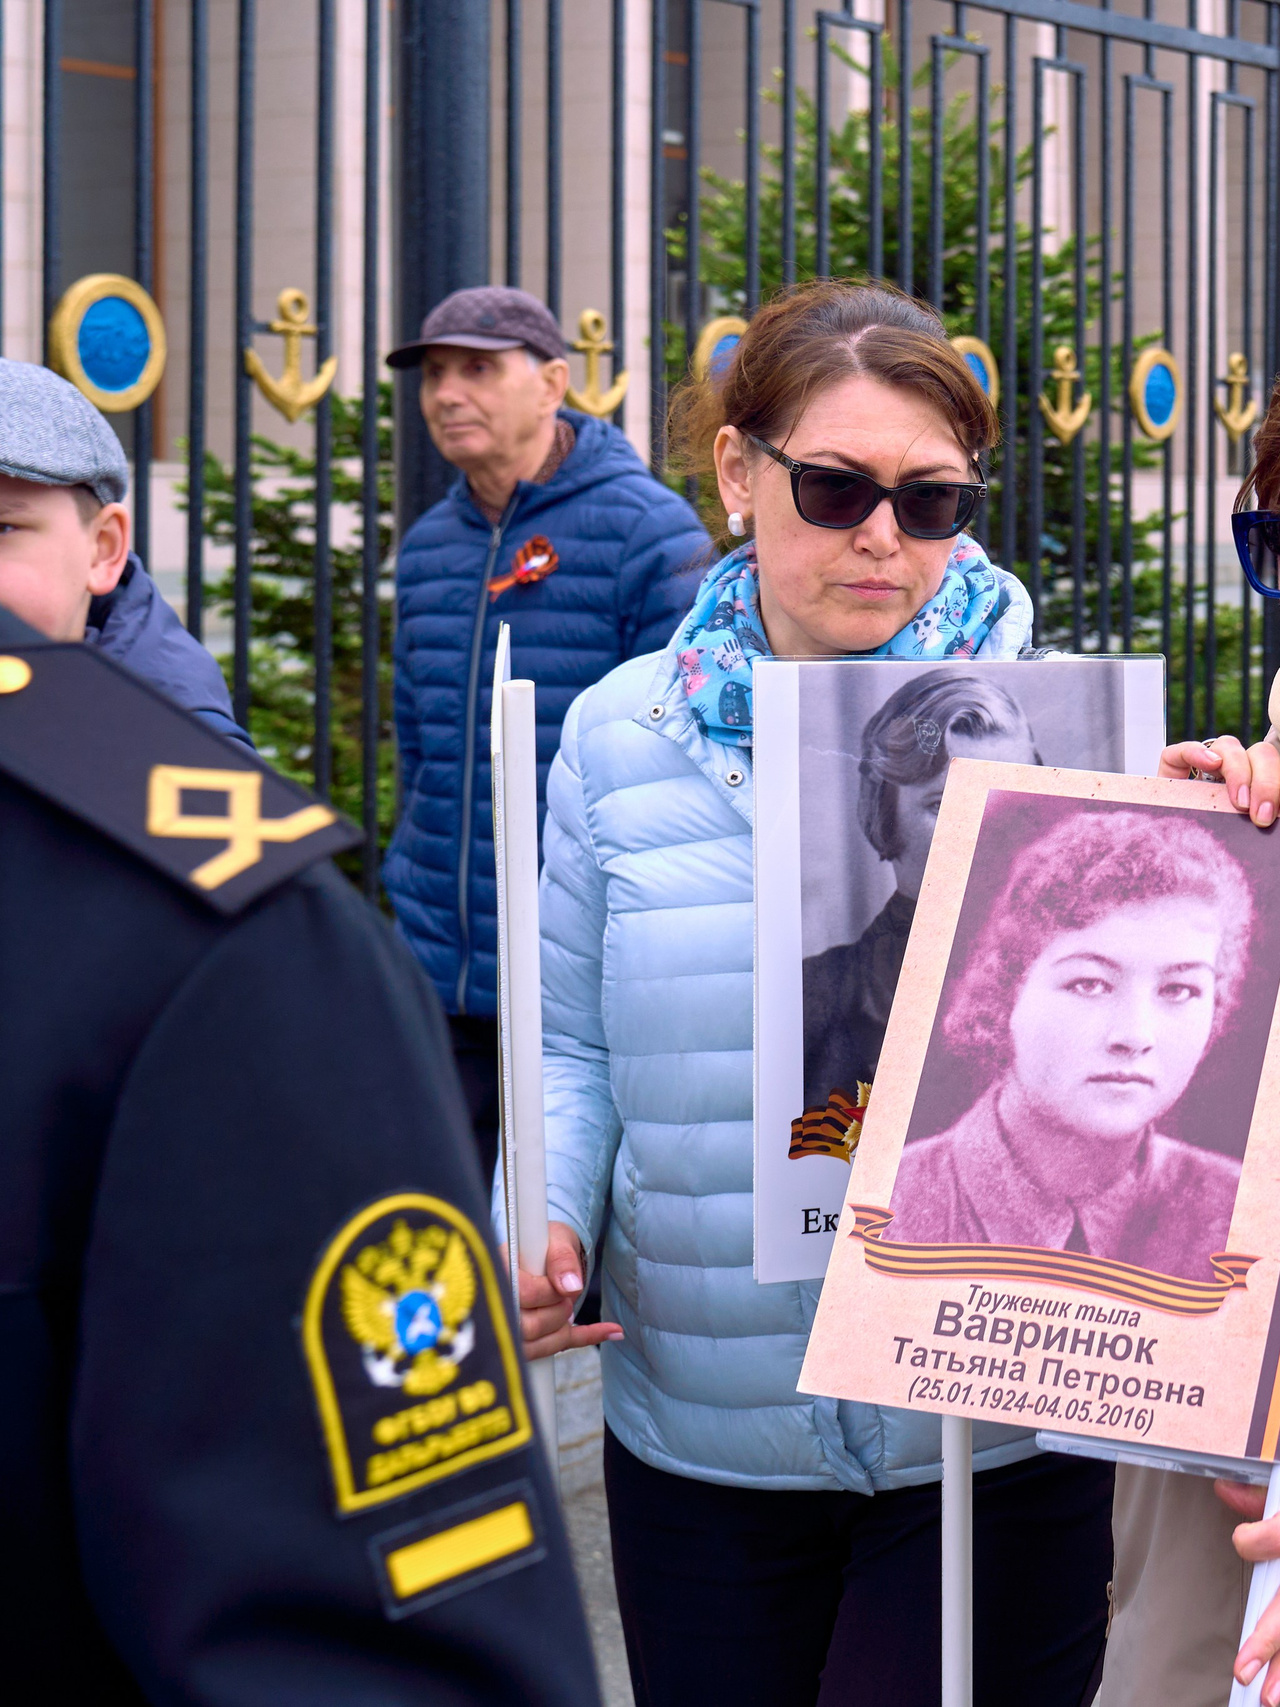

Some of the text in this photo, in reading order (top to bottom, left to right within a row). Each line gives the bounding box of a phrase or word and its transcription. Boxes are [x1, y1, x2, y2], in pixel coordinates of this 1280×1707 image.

[932, 1299, 1159, 1366] Вавринюк
[967, 1283, 1141, 1328] Труженик тыла
[892, 1335, 1205, 1408] Татьяна Петровна
[907, 1375, 1156, 1437] (25.01.1924-04.05.2016)
